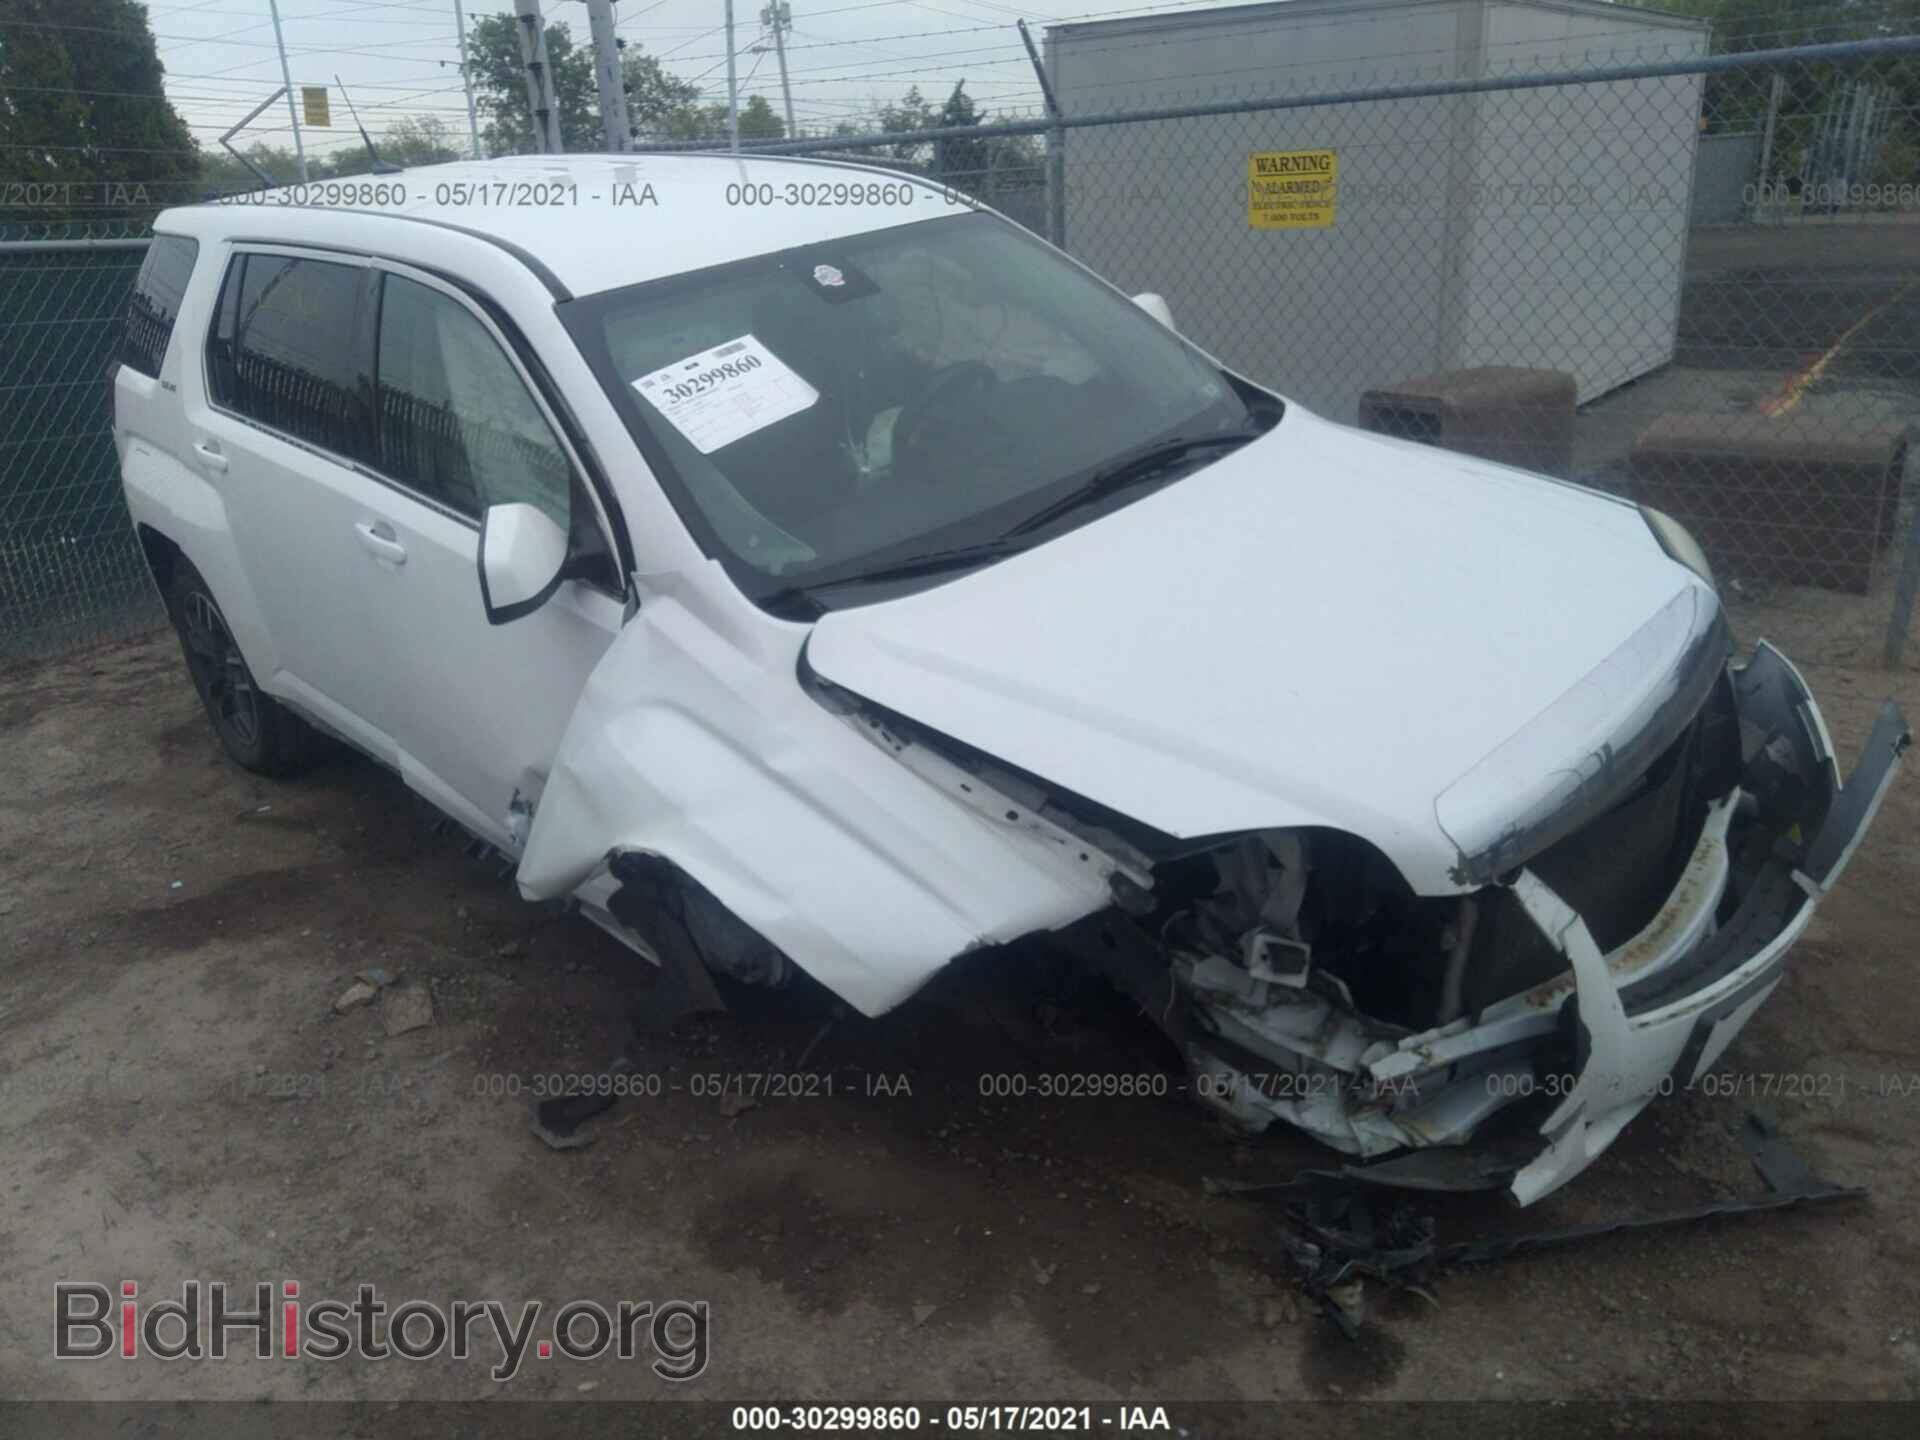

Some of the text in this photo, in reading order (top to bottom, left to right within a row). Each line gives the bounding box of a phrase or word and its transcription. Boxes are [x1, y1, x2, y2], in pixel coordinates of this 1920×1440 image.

[1256, 155, 1330, 172] WARNING
[1265, 180, 1320, 194] ALARMED
[664, 354, 762, 404] 30299860
